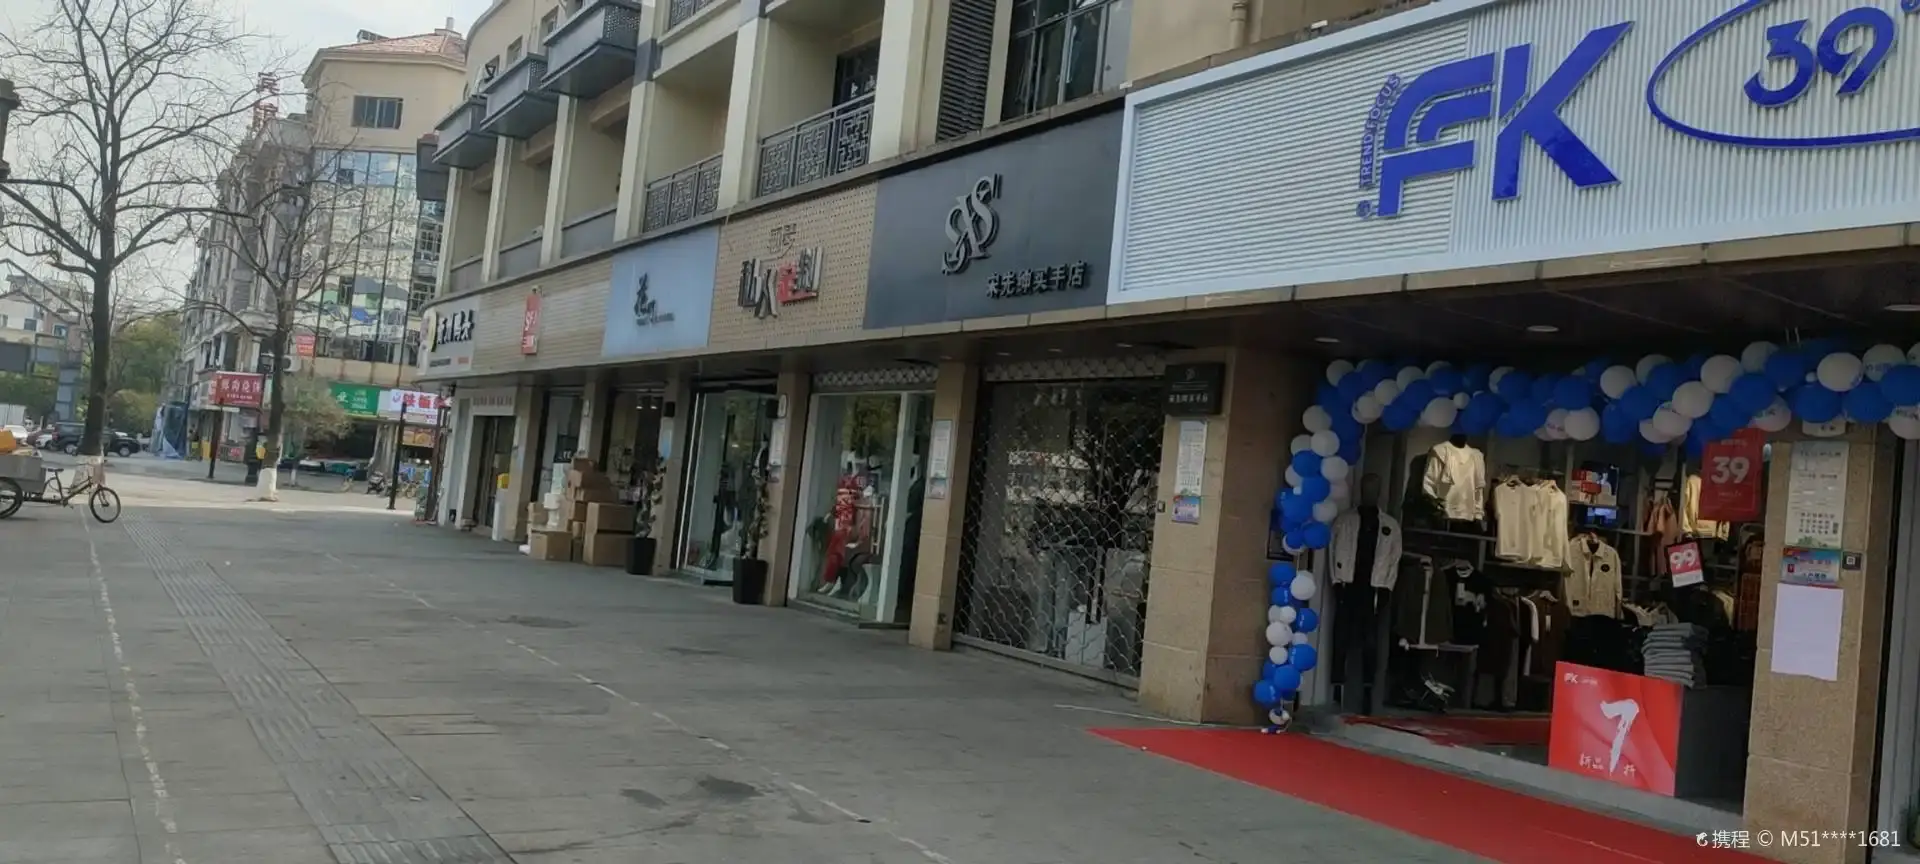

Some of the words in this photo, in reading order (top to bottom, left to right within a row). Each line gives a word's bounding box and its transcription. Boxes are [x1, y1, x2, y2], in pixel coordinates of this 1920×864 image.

[1744, 7, 1895, 107] 39
[1365, 72, 1401, 133] FOCUS
[1377, 20, 1635, 217] FK
[1359, 132, 1375, 188] TREND
[1710, 455, 1750, 484] 39
[1670, 549, 1697, 571] 99
[1600, 698, 1640, 776] 7
